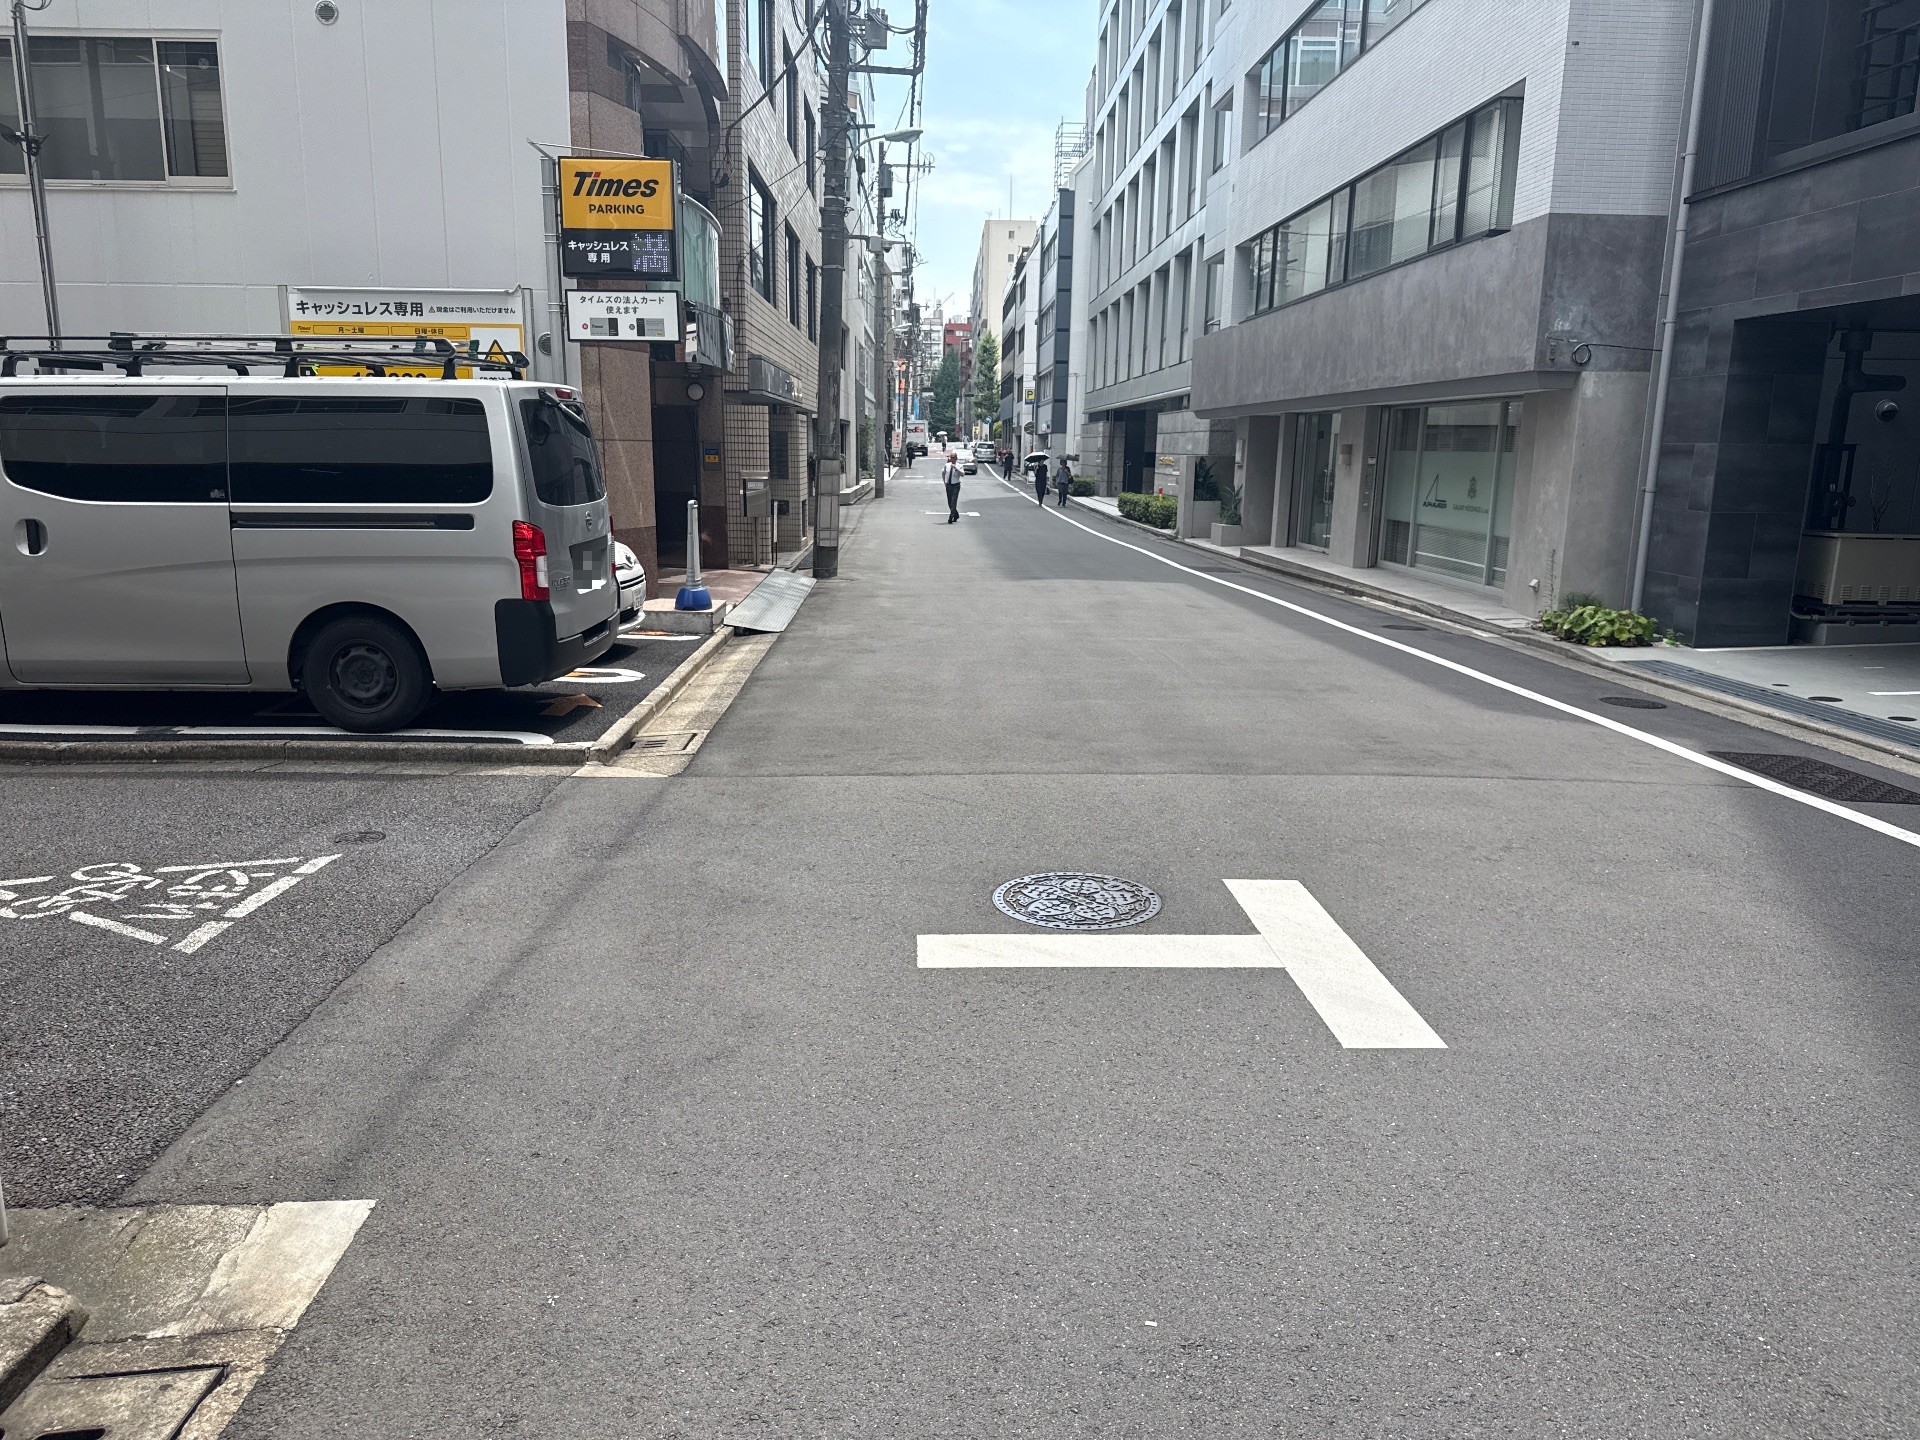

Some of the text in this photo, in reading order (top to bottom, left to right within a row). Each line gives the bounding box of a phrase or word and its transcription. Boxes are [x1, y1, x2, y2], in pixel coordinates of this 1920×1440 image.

[573, 171, 659, 197] Times
[588, 203, 645, 215] PARKING
[567, 240, 629, 251] キャッシュレス
[587, 252, 611, 264] 専用
[633, 233, 670, 273] 満
[580, 295, 665, 305] タイムズの法人カード
[296, 300, 515, 317] キャッシュレス専用 現金はご利用いただけません
[606, 306, 639, 315] 使えます
